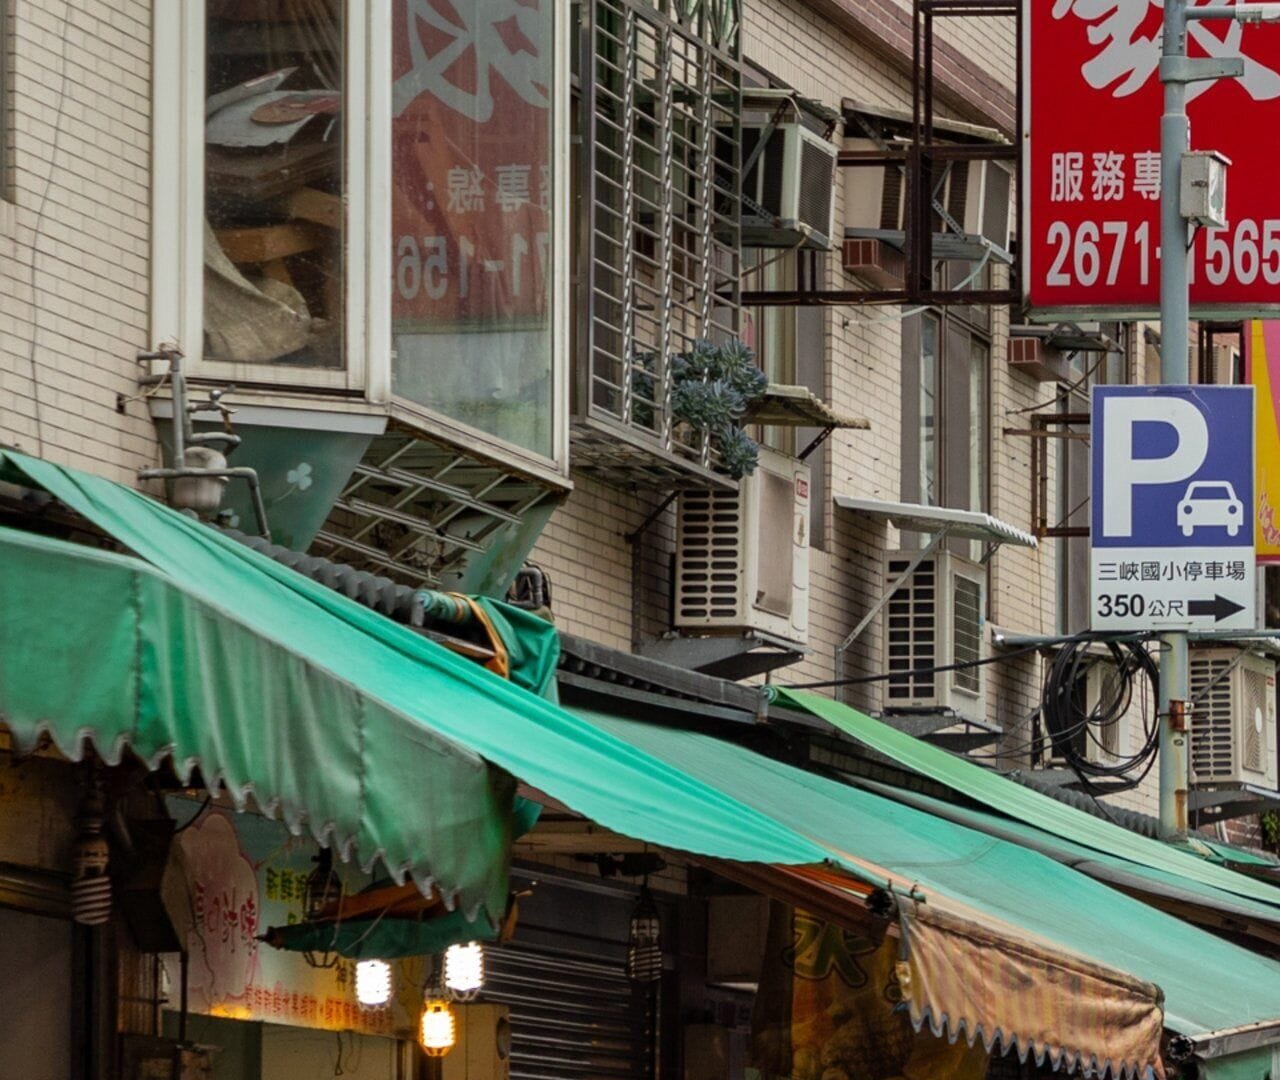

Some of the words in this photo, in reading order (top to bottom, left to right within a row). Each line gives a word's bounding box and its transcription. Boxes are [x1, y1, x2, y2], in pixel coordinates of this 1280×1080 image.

[1103, 397, 1209, 537] P
[1097, 560, 1247, 582] 三峽國小停車場
